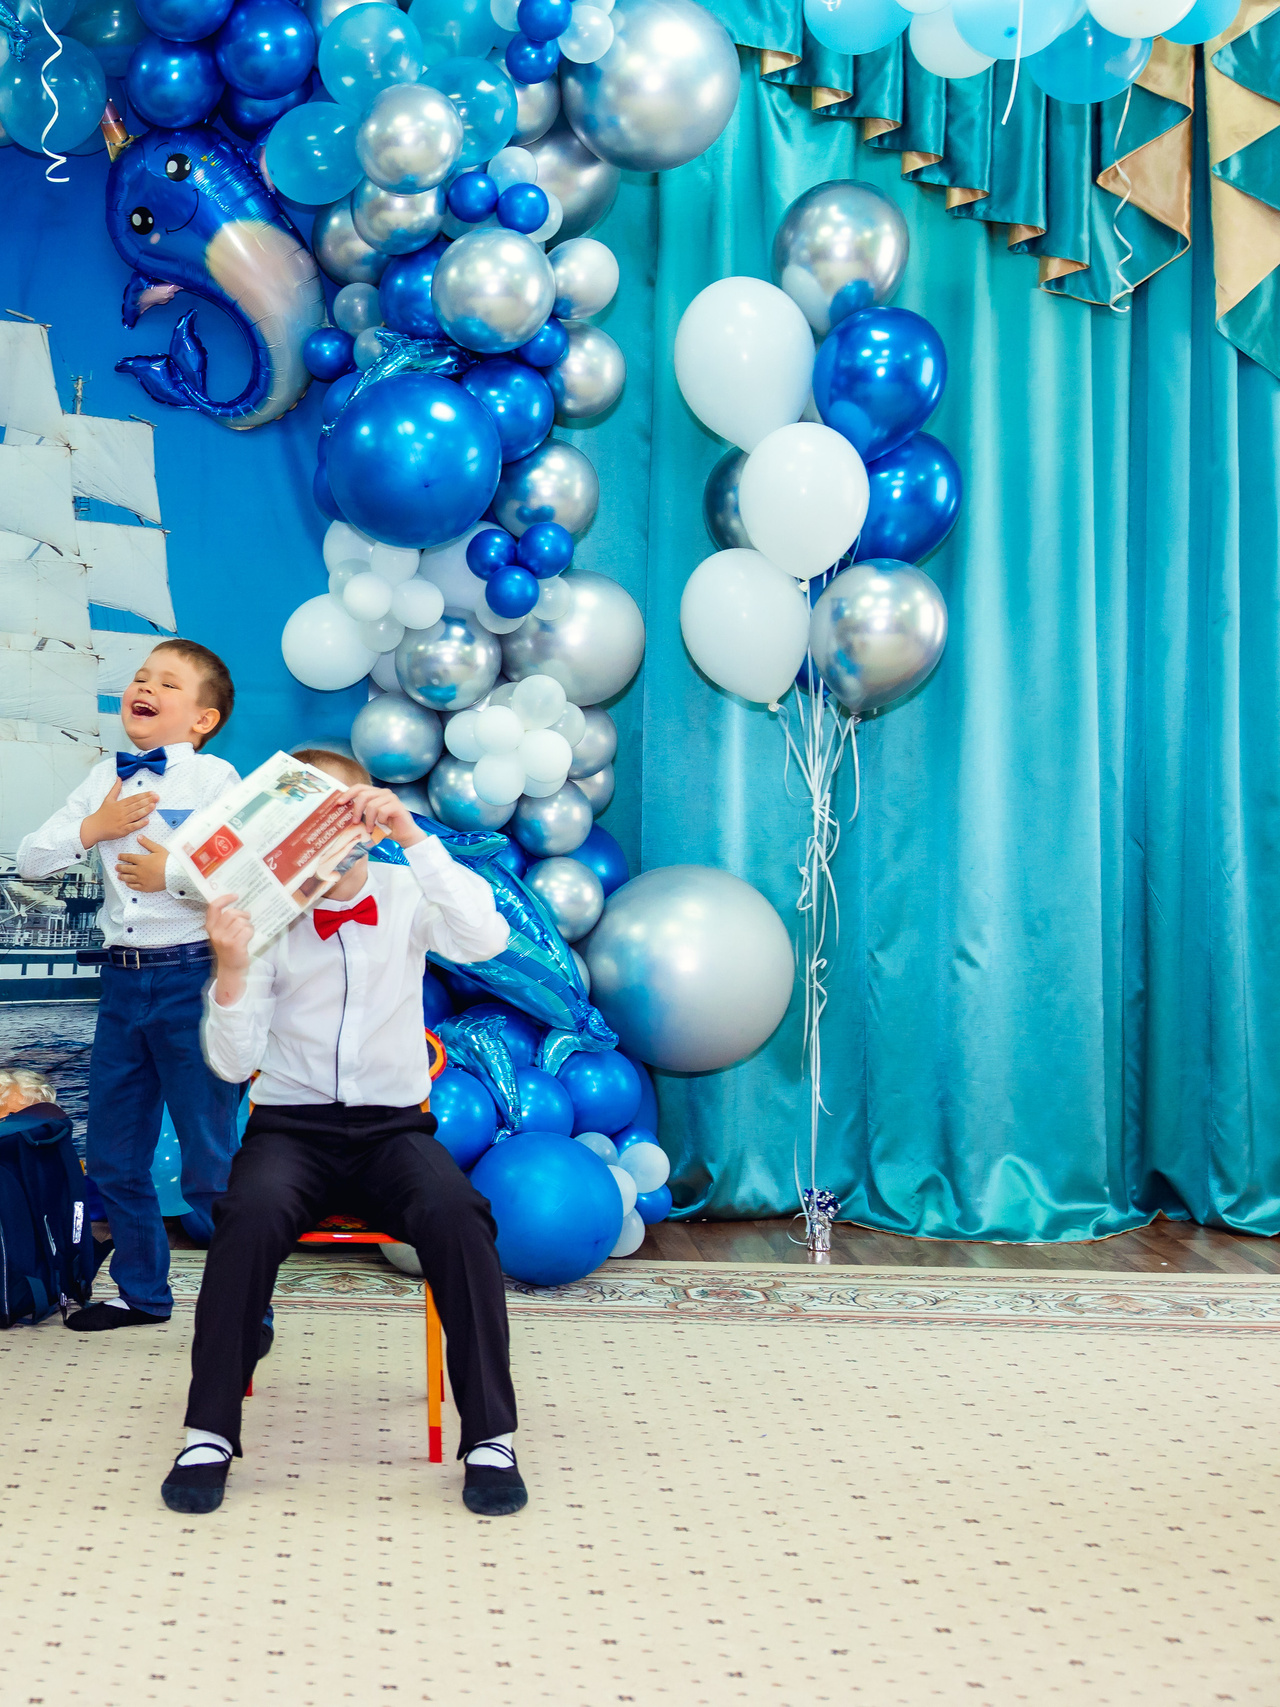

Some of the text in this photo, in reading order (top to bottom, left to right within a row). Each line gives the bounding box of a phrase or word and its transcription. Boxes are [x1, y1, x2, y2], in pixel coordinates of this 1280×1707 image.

[305, 803, 348, 844] нетерпением
[336, 807, 356, 829] овый
[312, 824, 338, 849] корпус
[265, 856, 279, 870] 2
[295, 845, 316, 867] ждем
[206, 878, 219, 891] 9
